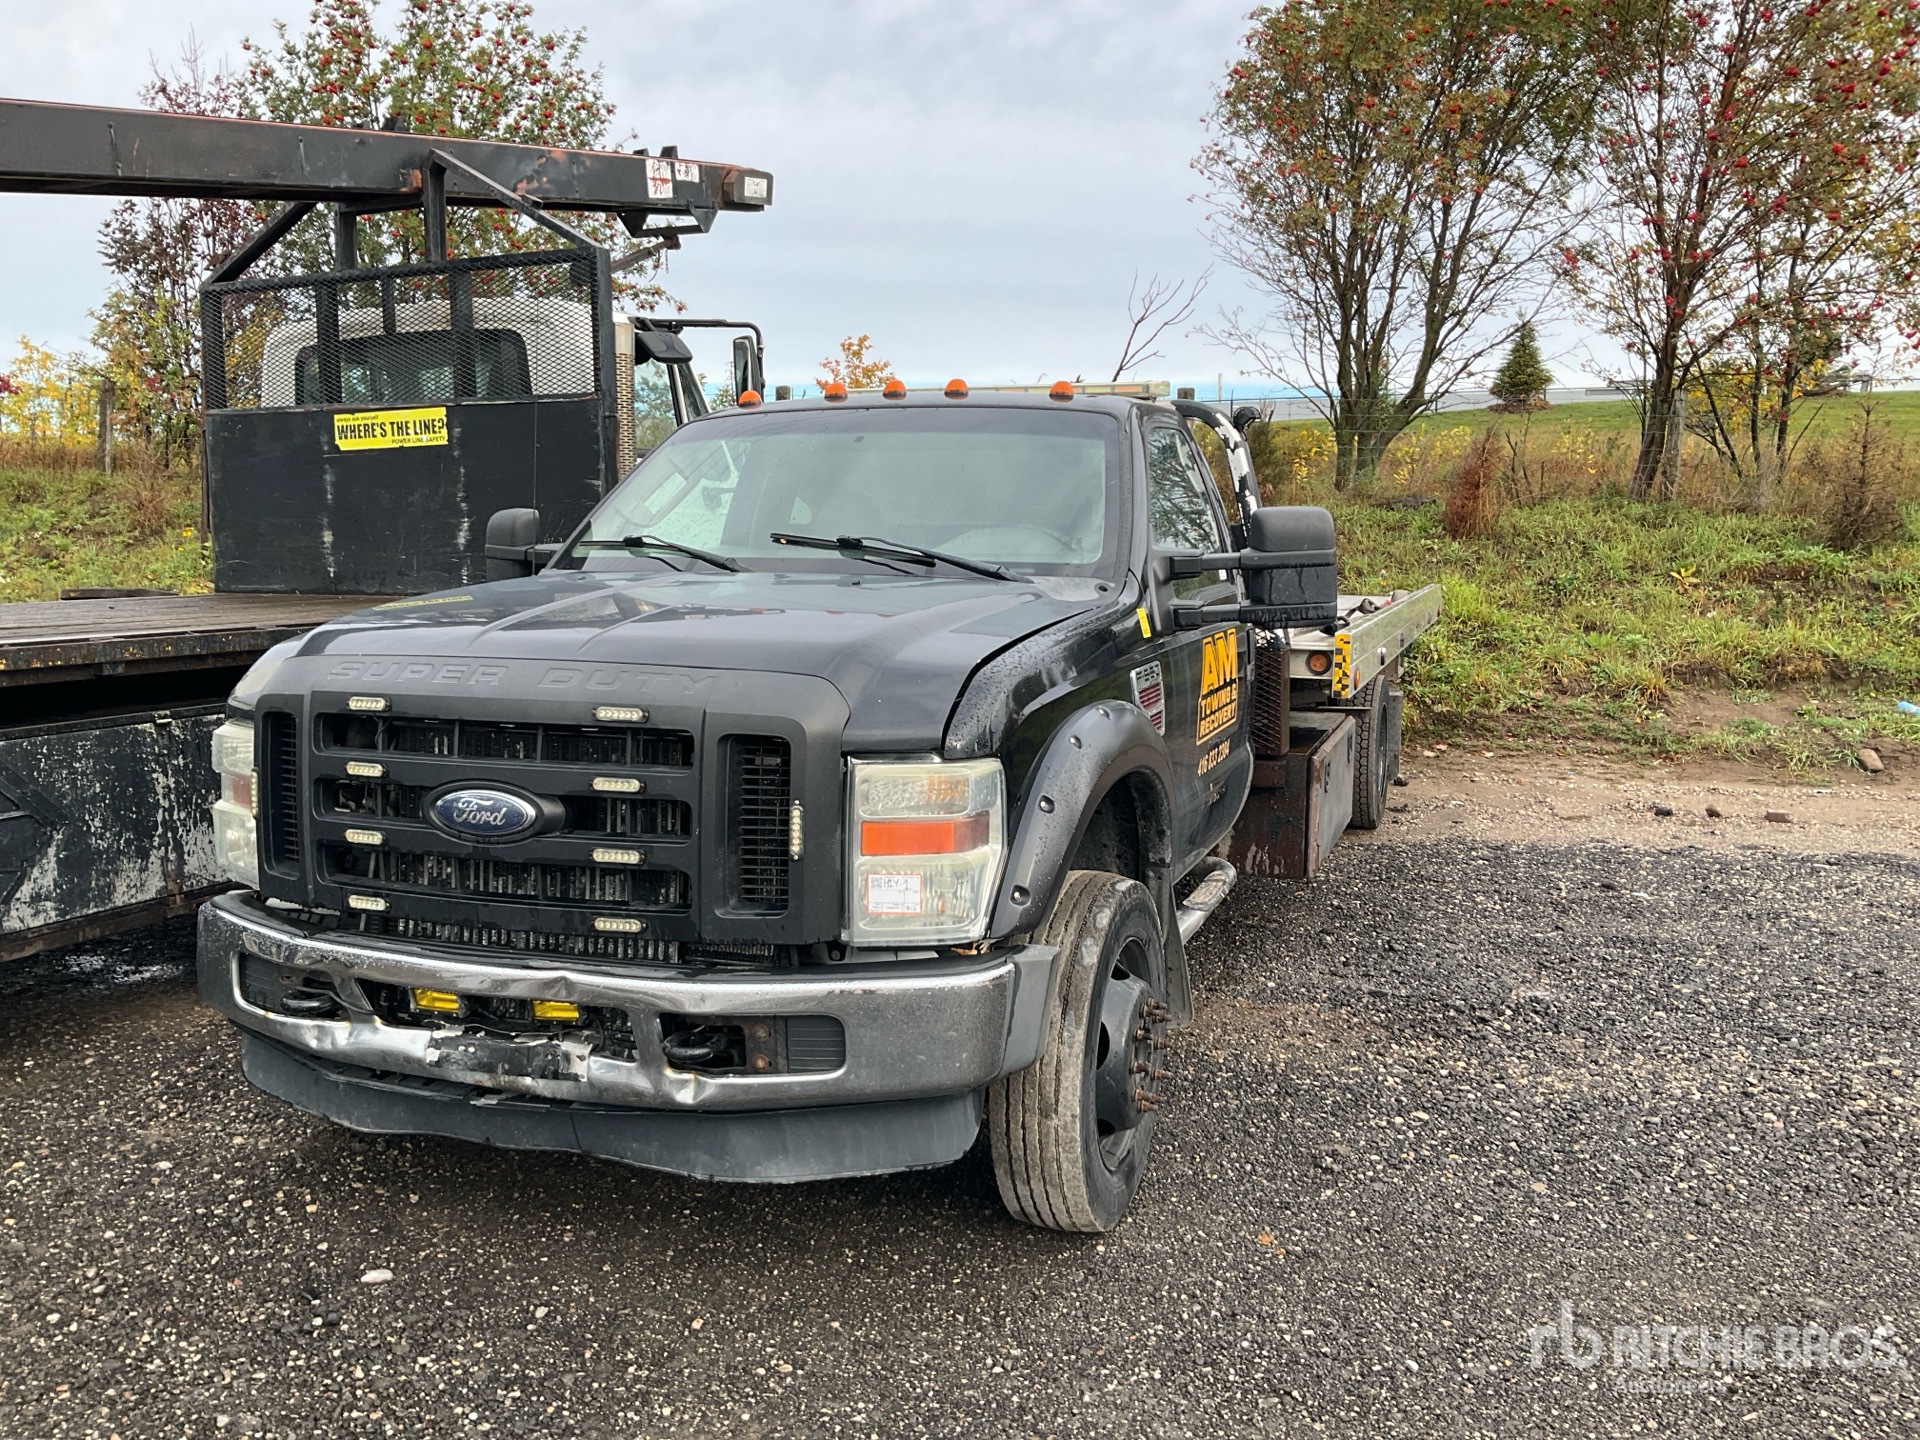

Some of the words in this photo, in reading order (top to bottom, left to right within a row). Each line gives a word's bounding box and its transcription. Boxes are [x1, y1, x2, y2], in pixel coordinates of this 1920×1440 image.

[337, 421, 387, 440] WHERE'S
[389, 419, 410, 437] THE
[413, 417, 445, 436] LINE?
[361, 414, 379, 422] yourself
[391, 437, 412, 445] POWER
[1202, 628, 1237, 695] AM
[326, 661, 510, 686] SUPER
[538, 667, 719, 695] DUTY
[1201, 686, 1231, 718] TOWING
[1231, 683, 1238, 700] &
[1200, 701, 1236, 738] RECOVERY
[453, 797, 508, 826] Ford
